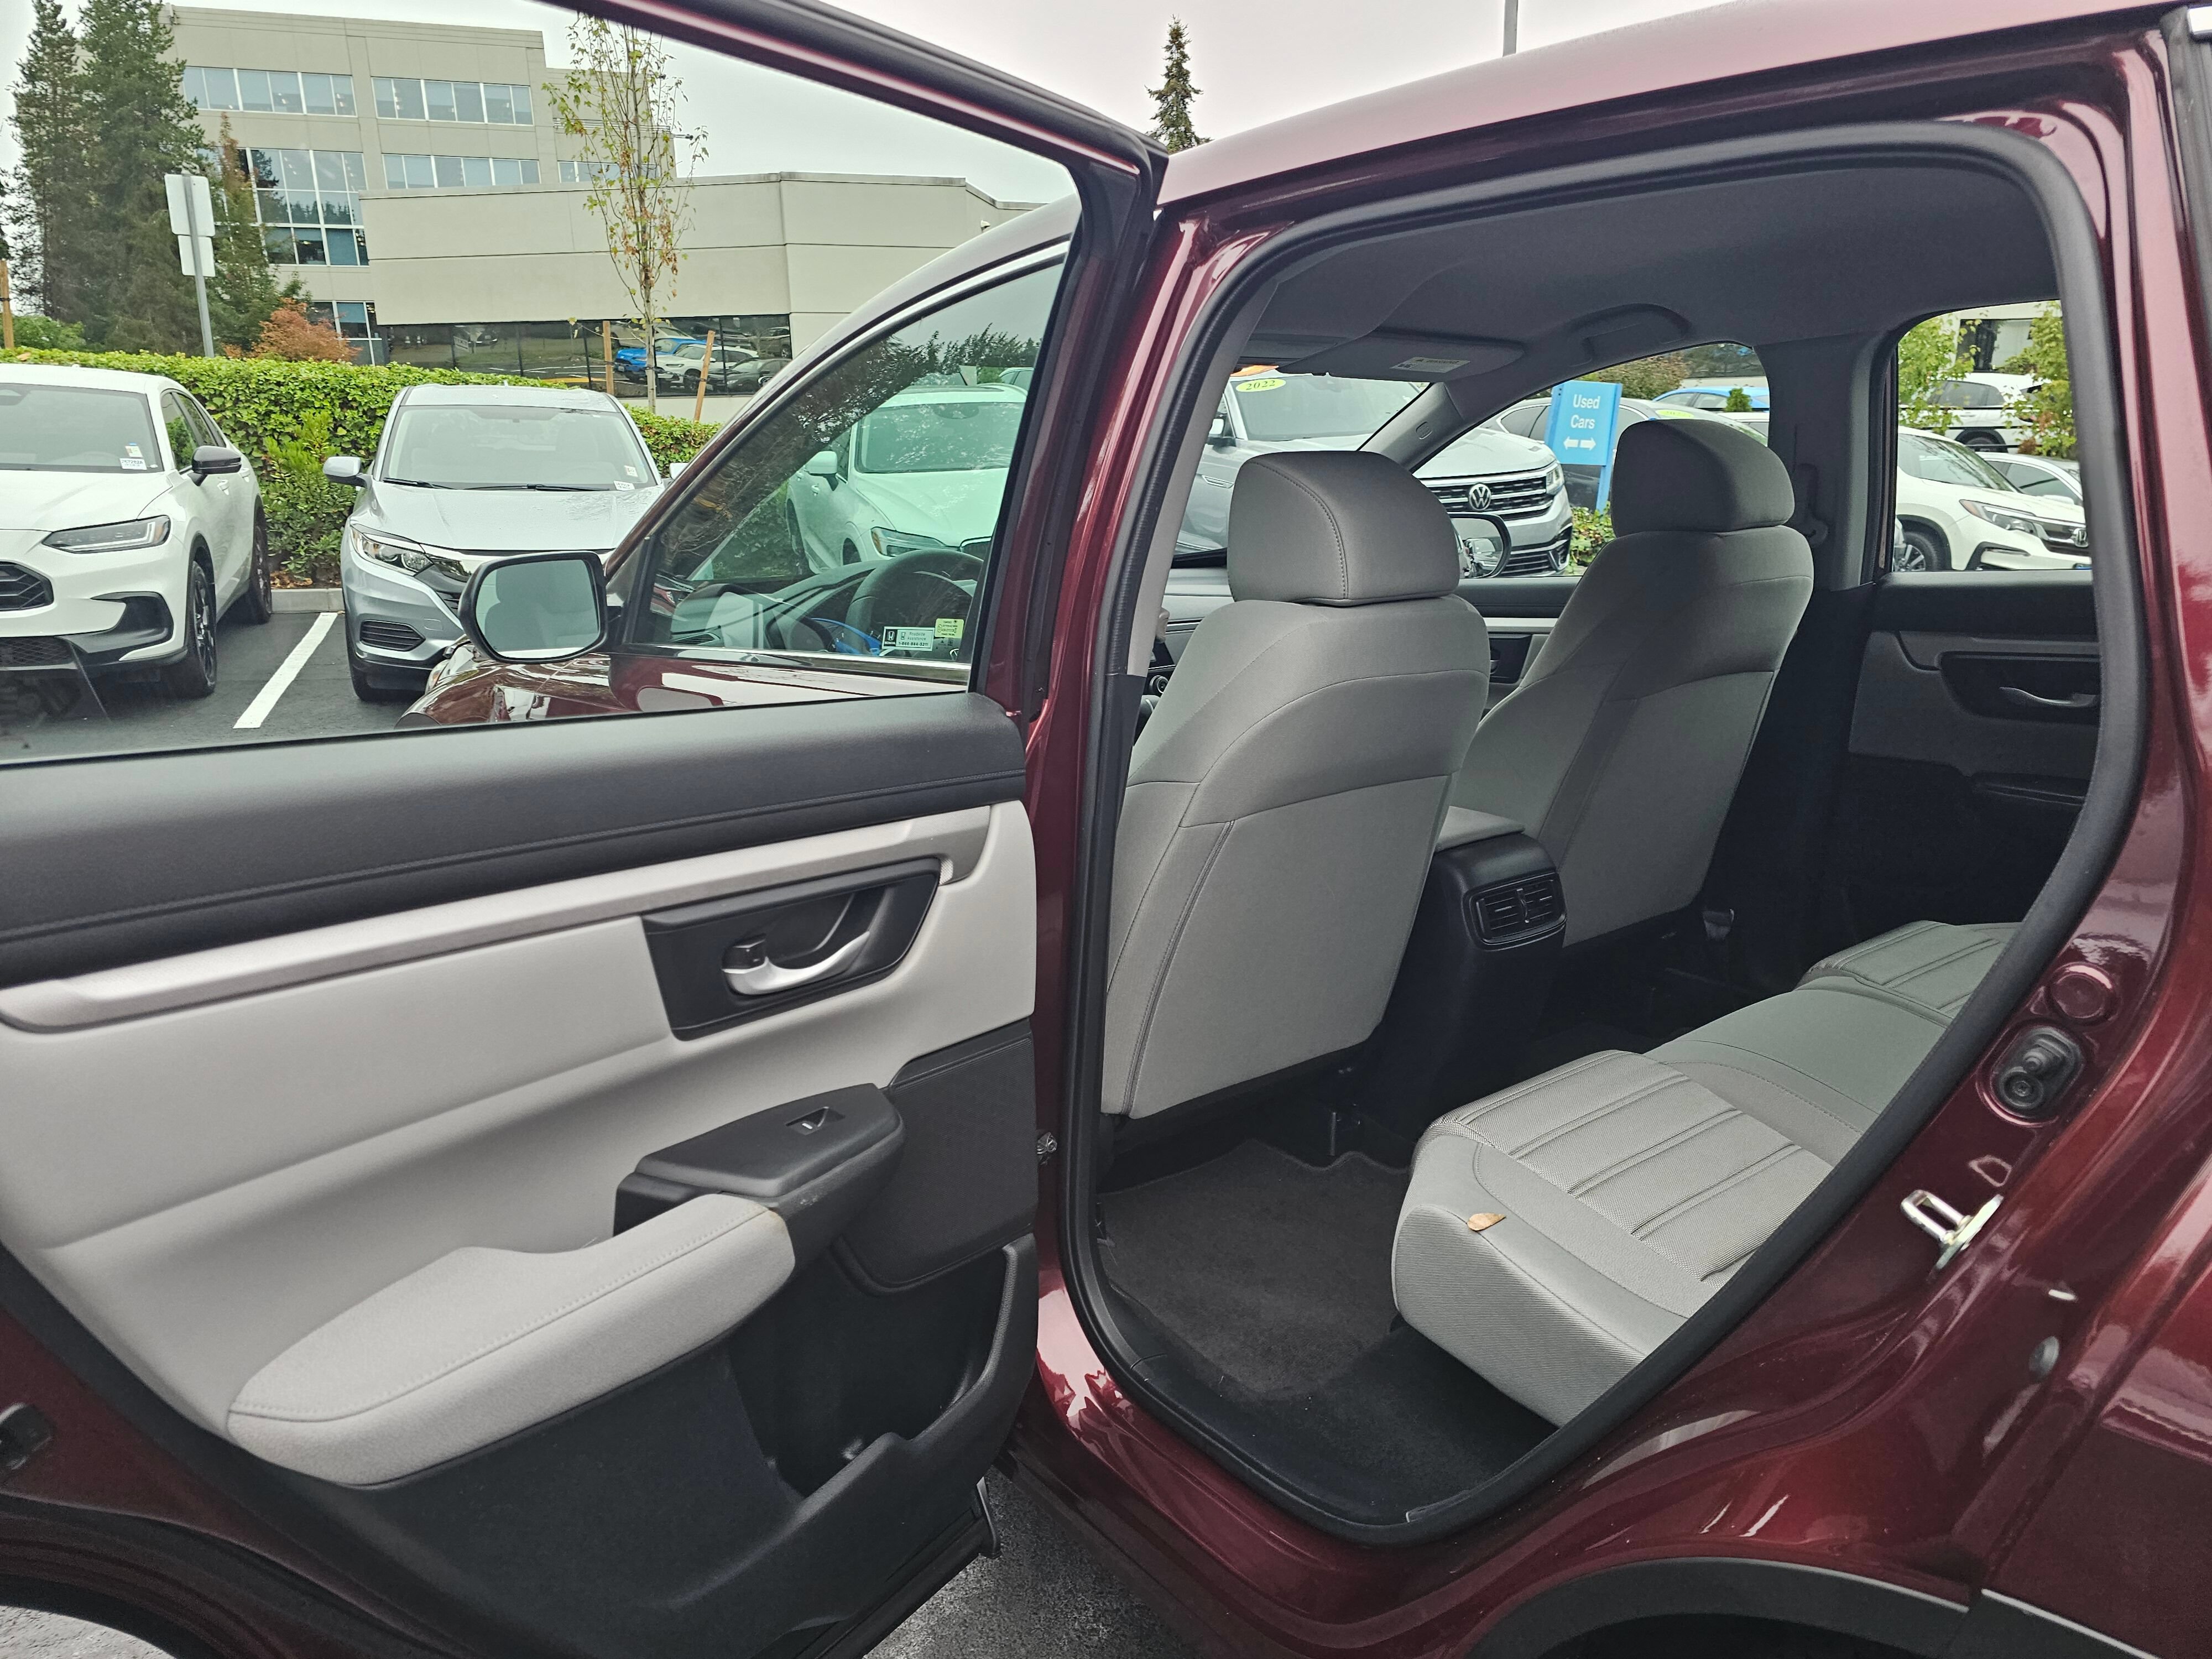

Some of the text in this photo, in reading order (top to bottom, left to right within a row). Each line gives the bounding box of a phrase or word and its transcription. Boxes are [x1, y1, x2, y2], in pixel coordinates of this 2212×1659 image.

[1245, 380, 1275, 390] 2022
[1572, 394, 1601, 409] Used
[1570, 415, 1595, 429] Cars
